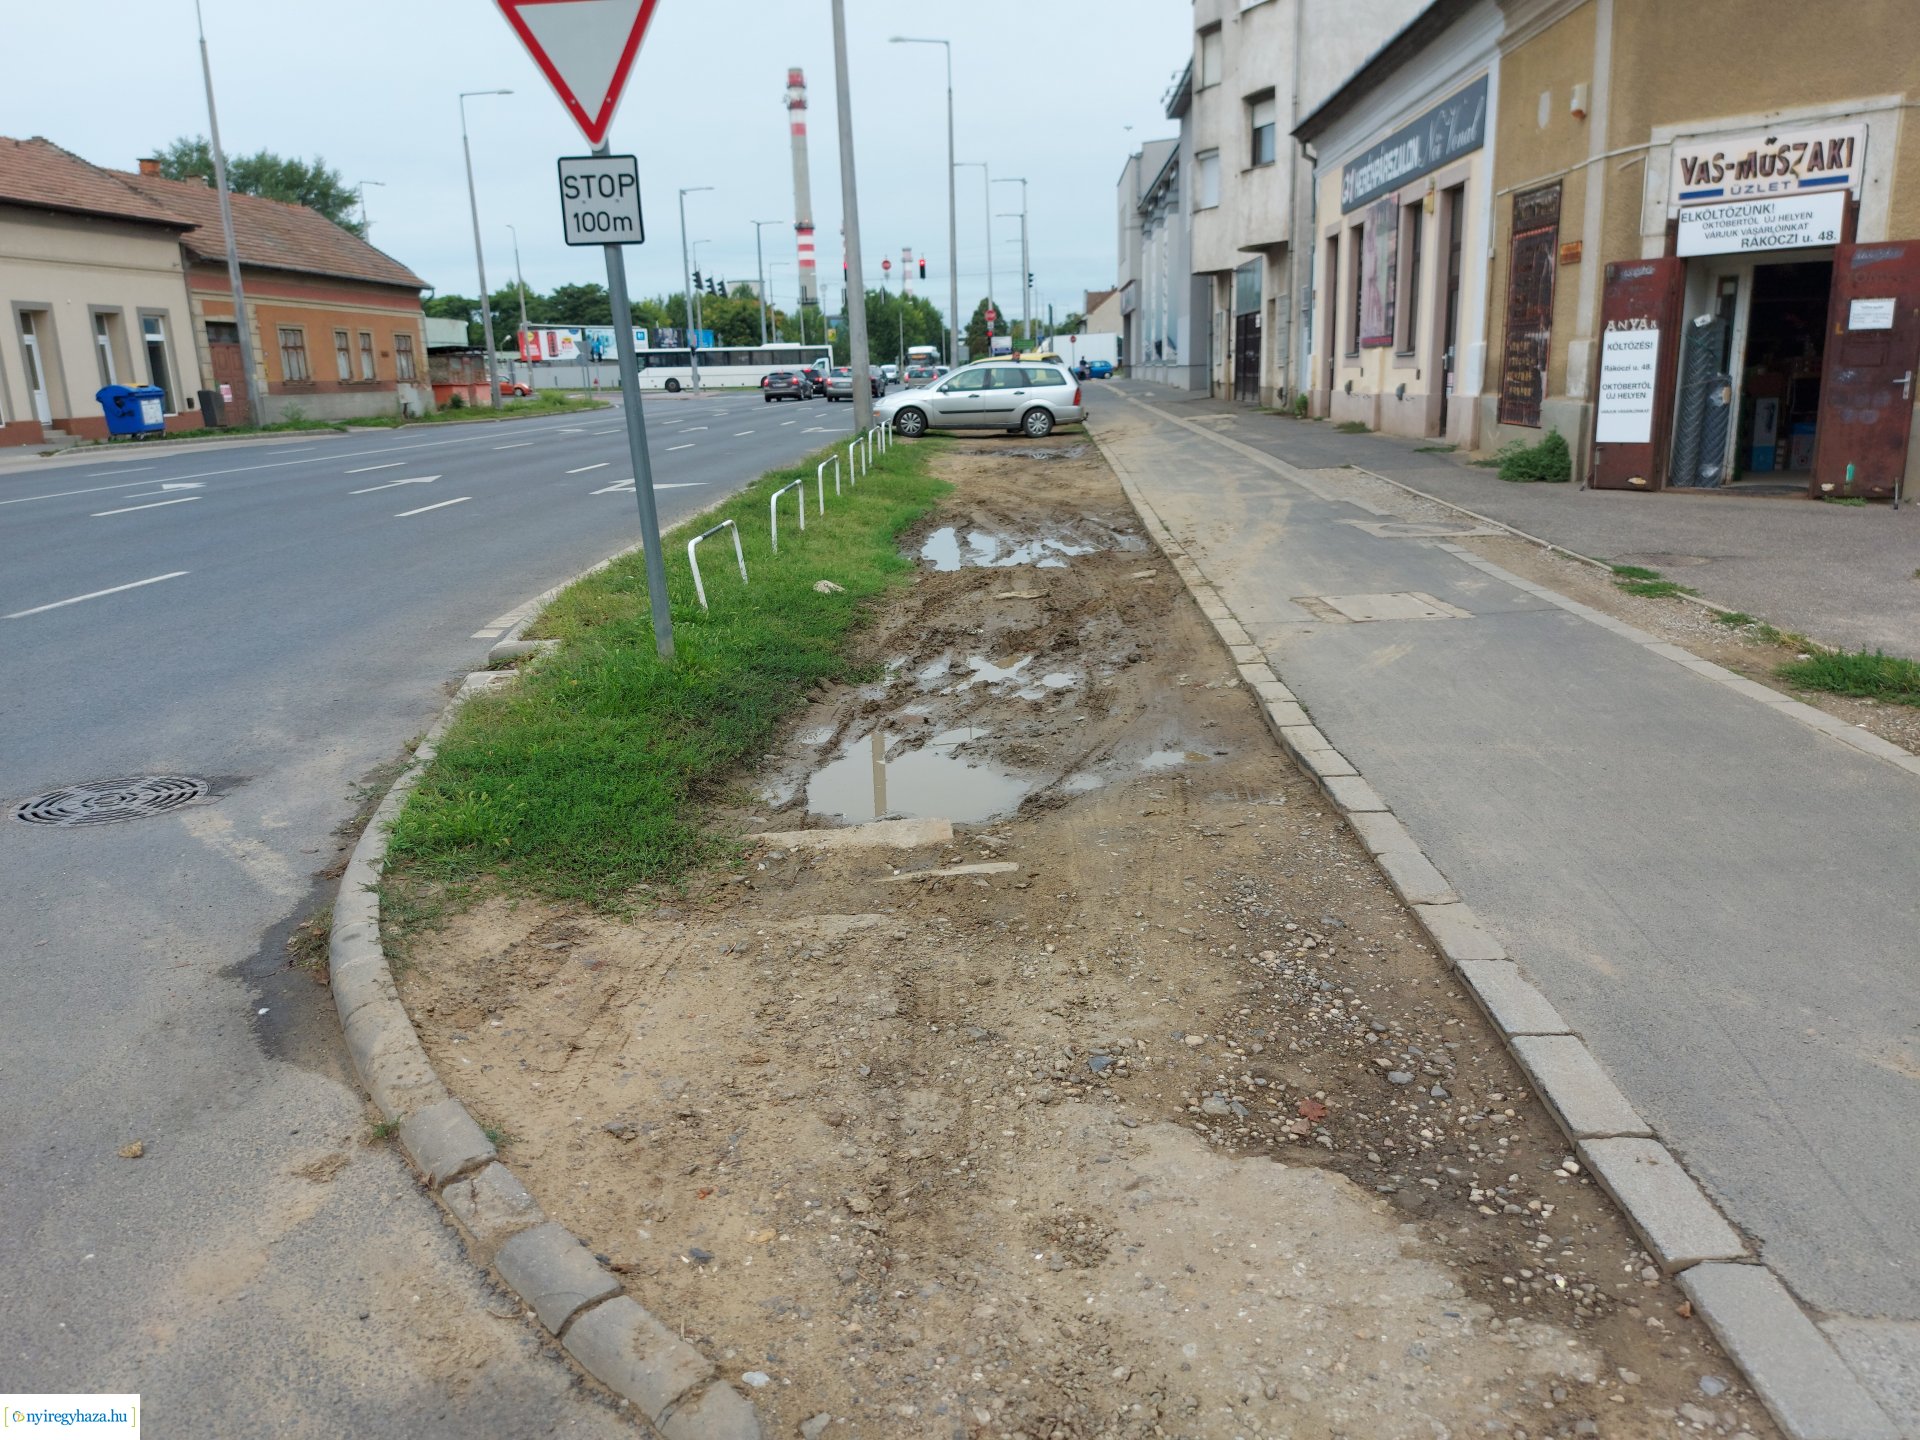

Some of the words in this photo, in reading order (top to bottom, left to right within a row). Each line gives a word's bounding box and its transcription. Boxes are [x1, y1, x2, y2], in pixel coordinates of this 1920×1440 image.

[1680, 137, 1855, 186] VAS-MŰSZAKI
[564, 173, 635, 199] STOP
[1730, 181, 1792, 196] ÜZLET
[573, 211, 633, 233] 100m
[1681, 203, 1775, 223] ELKÖLTÖZÜNK!
[1741, 233, 1799, 249] RÁKÓCZI
[1818, 230, 1837, 242] 48.
